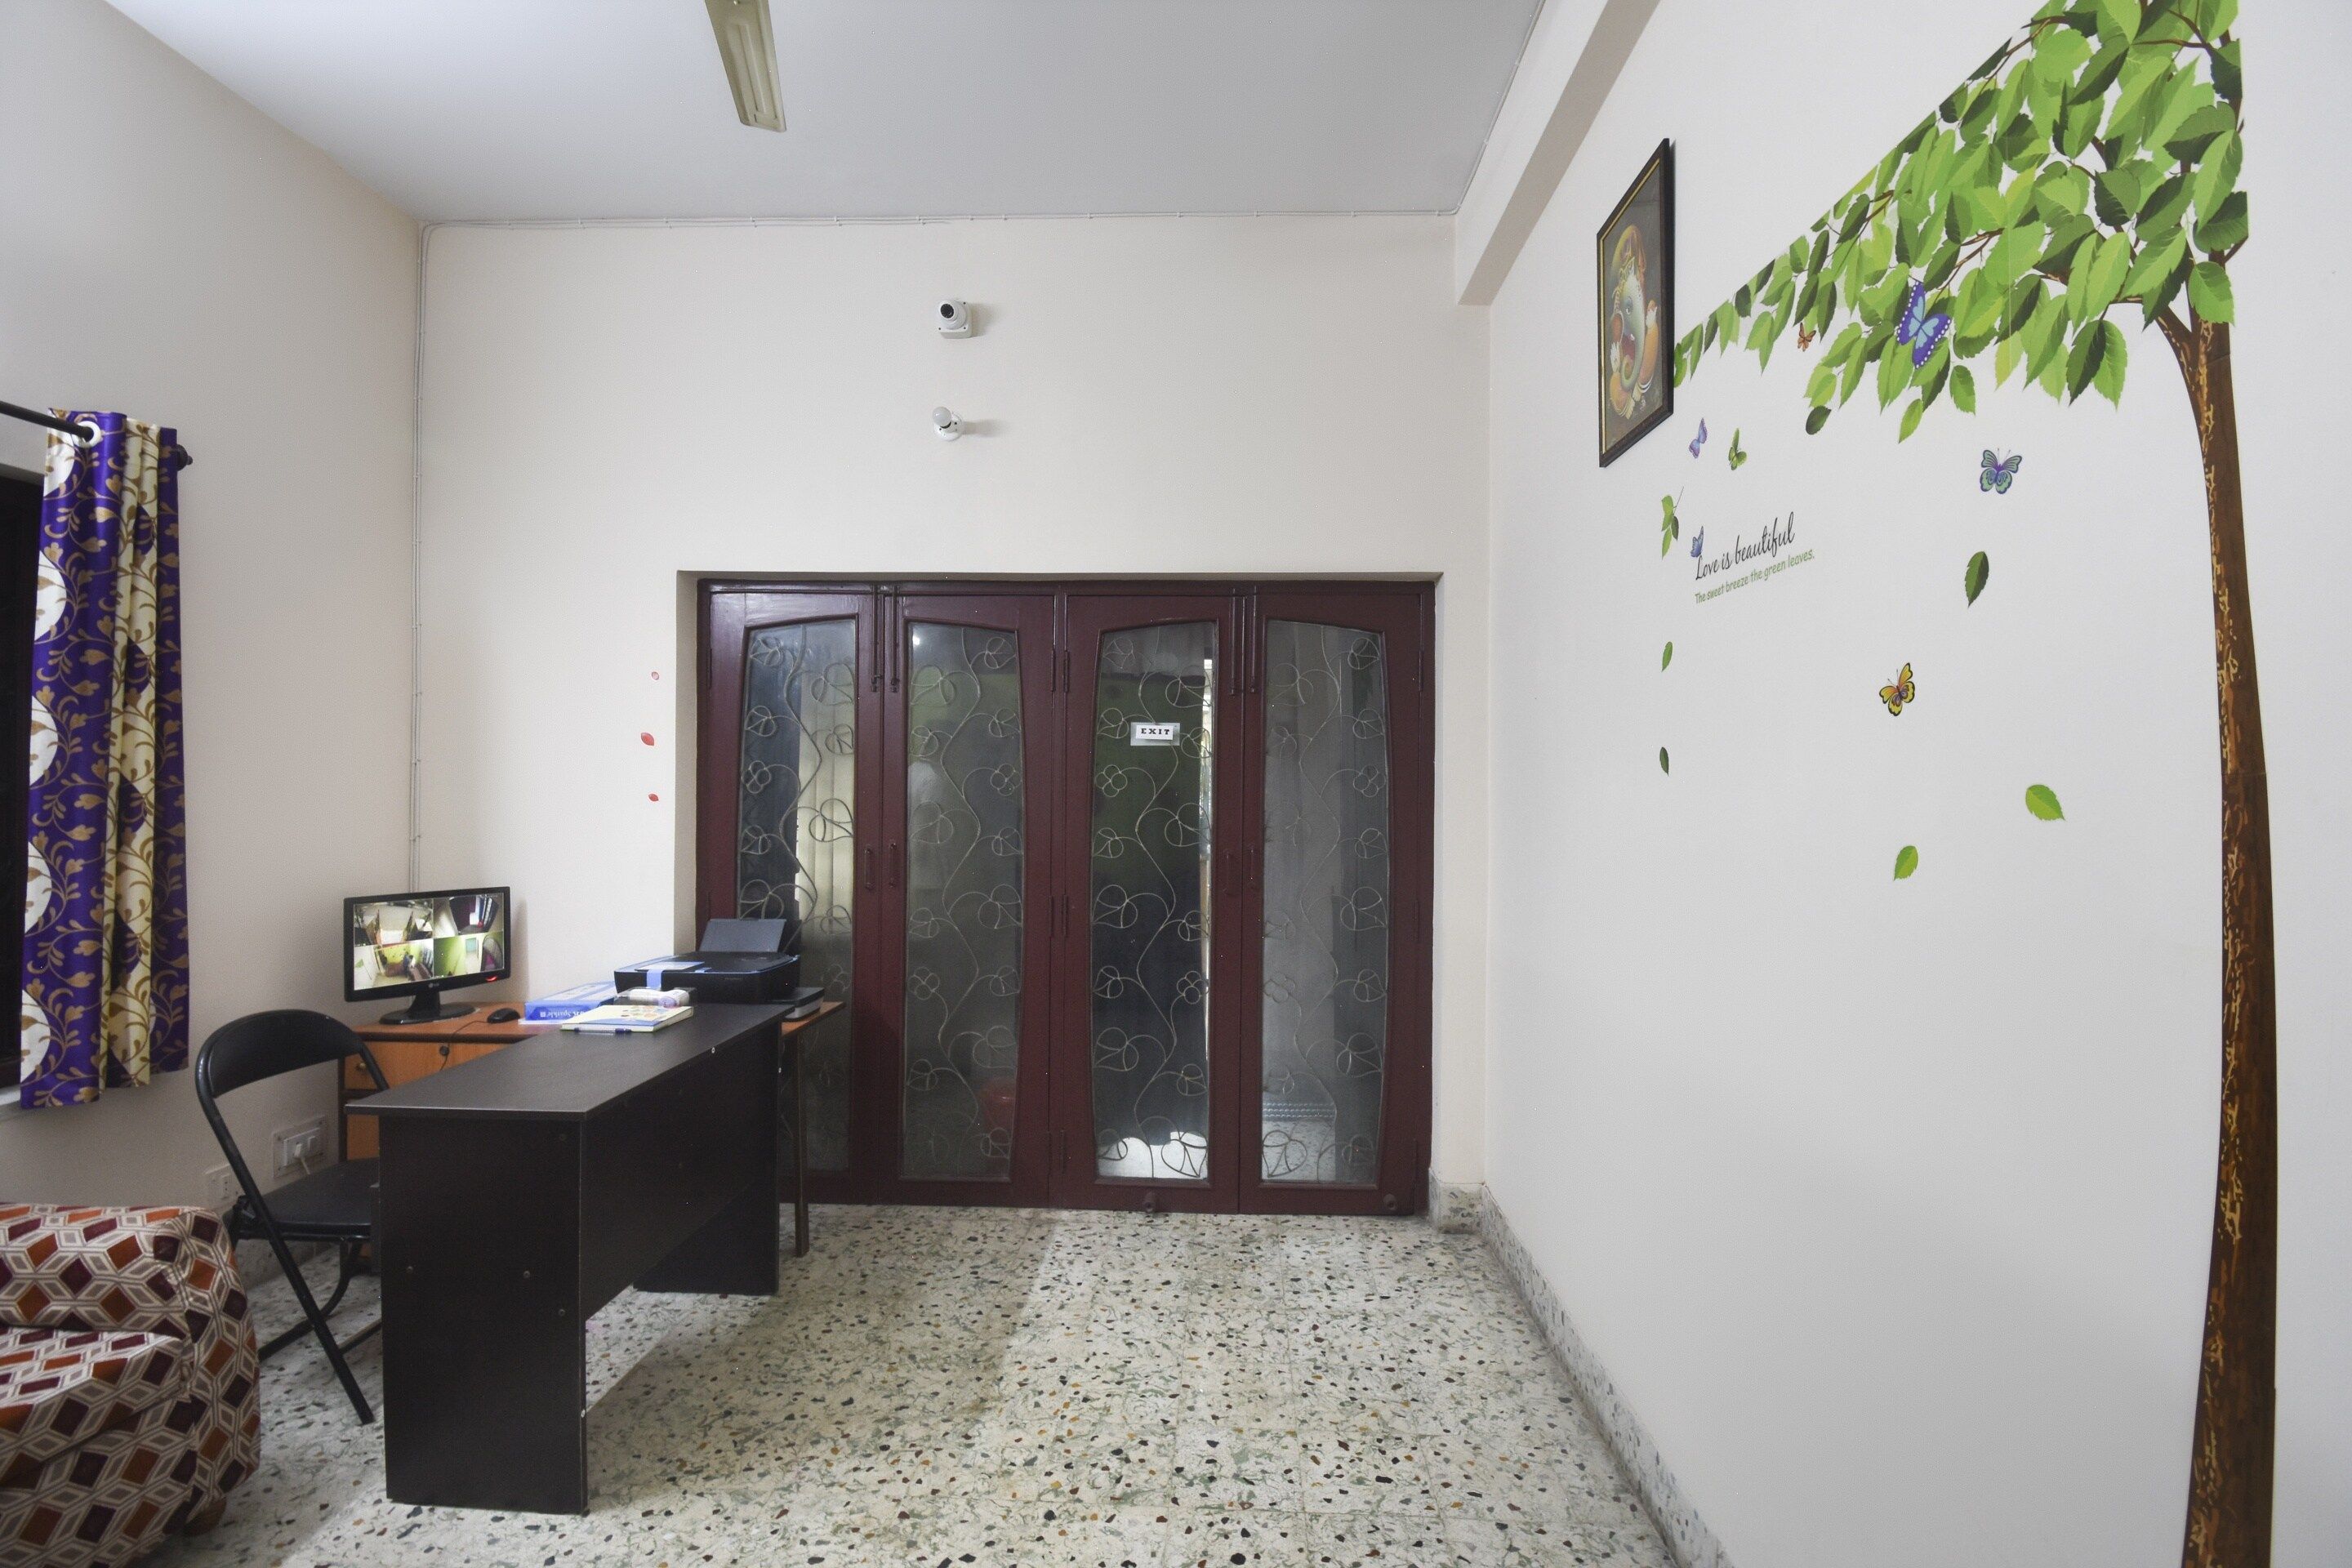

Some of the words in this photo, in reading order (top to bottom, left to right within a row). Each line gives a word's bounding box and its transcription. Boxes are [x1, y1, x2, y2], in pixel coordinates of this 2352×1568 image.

[1695, 555, 1719, 581] Love
[1722, 551, 1732, 570] is
[1735, 511, 1795, 565] beautiful
[1695, 593, 1706, 604] The
[1707, 585, 1724, 601] sweet
[1726, 575, 1748, 595] breeze
[1750, 570, 1762, 584] the
[1764, 560, 1786, 581] green
[1788, 548, 1815, 568] leaves.
[547, 1009, 571, 1018] Sparkle
